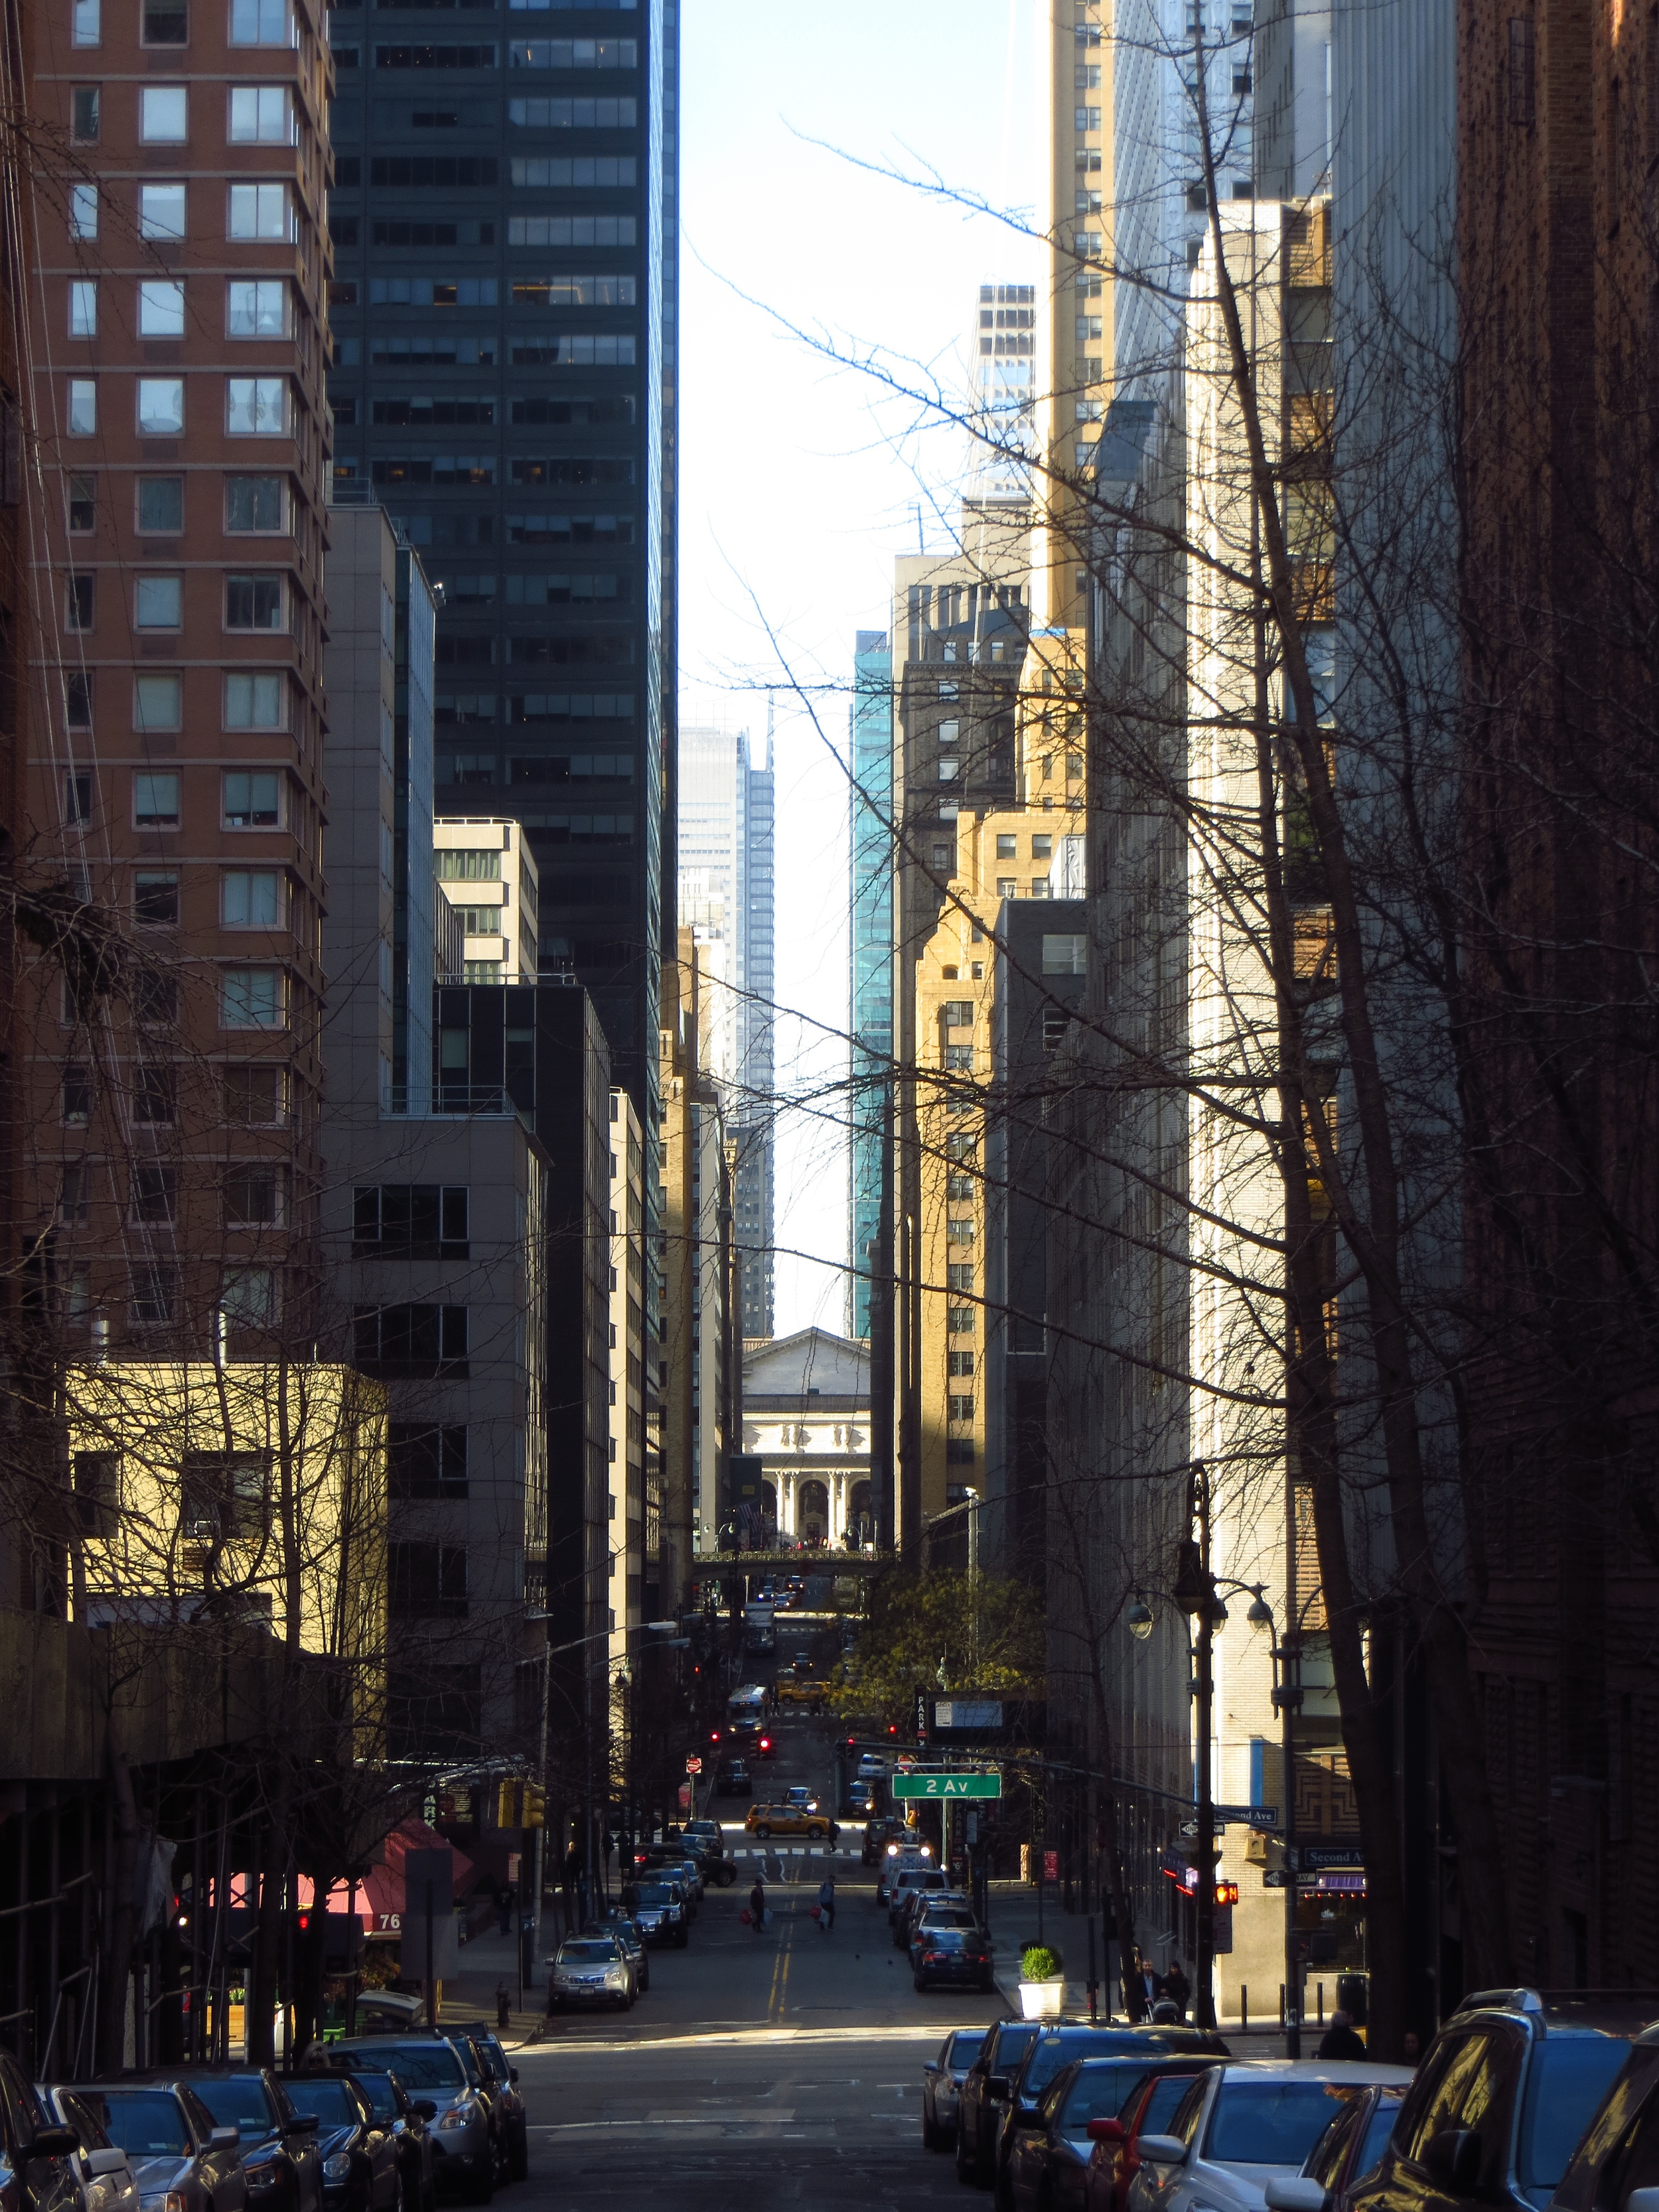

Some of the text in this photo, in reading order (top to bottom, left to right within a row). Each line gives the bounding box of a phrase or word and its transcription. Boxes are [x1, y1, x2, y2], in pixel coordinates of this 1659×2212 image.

[926, 1779, 968, 1793] 2 Av
[1254, 1811, 1271, 1820] Ave
[1311, 1852, 1350, 1862] Second
[380, 1913, 400, 1929] 76
